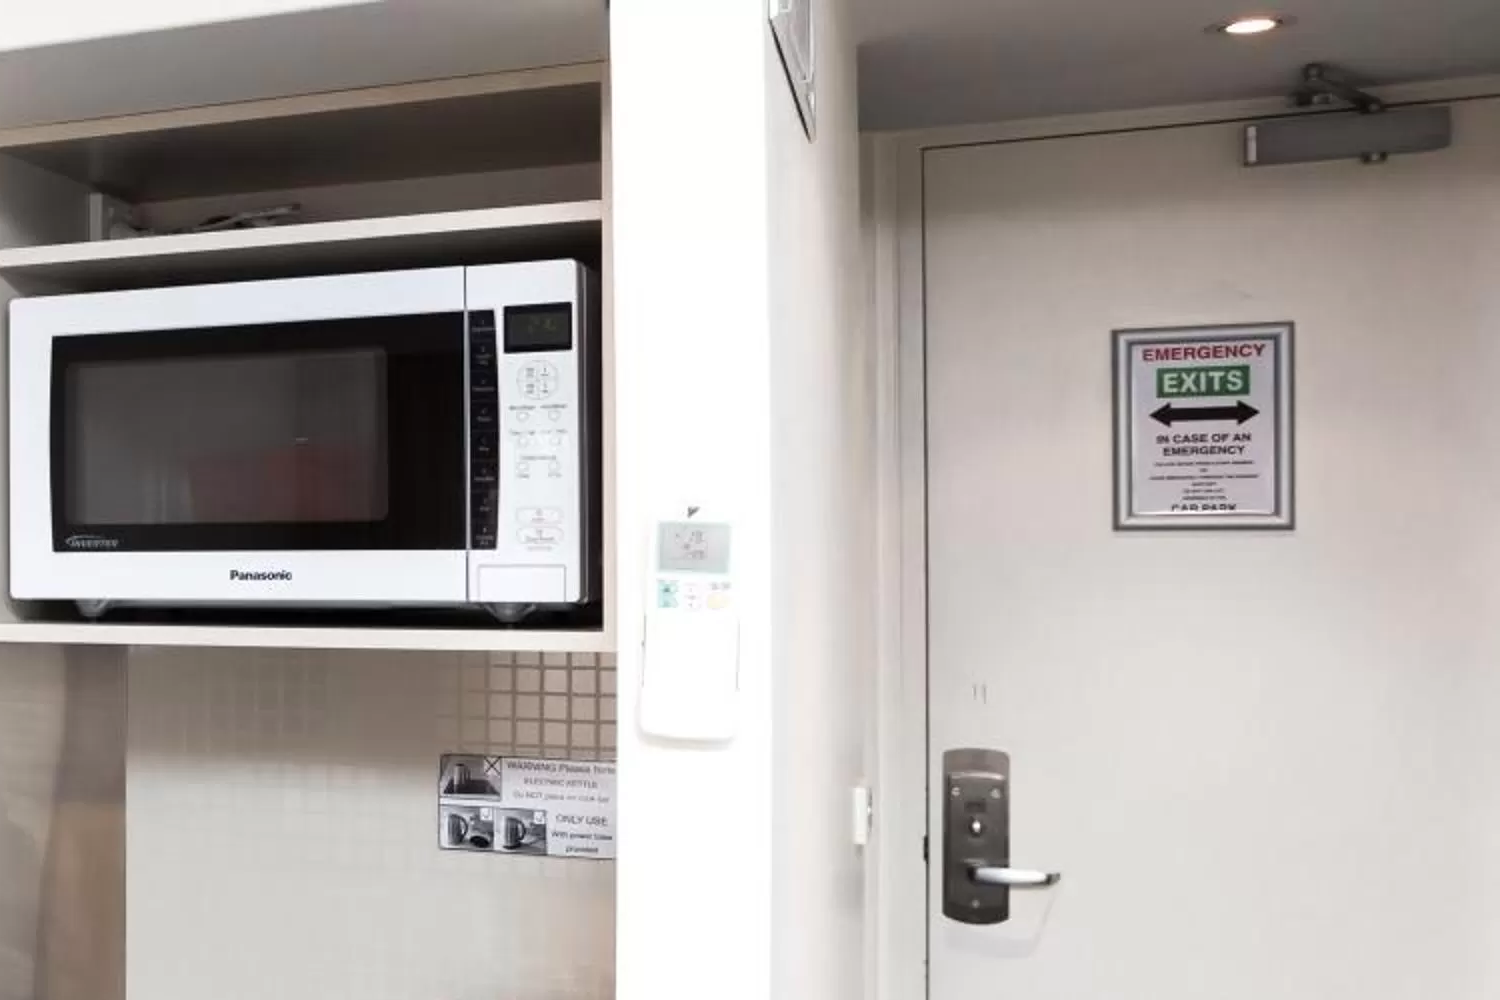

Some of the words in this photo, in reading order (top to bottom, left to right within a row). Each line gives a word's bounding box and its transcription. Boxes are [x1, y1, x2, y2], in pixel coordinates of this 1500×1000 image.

[1142, 343, 1266, 362] EMERGENCY
[1163, 370, 1244, 394] EXITS
[1156, 435, 1169, 444] IN
[1173, 434, 1209, 444] CASE
[1211, 433, 1229, 443] OF
[1232, 433, 1251, 442] AN
[1163, 445, 1245, 456] EMERGENCY
[229, 569, 293, 581] Panasonic
[556, 814, 583, 825] ONLY
[586, 816, 609, 827] USE
